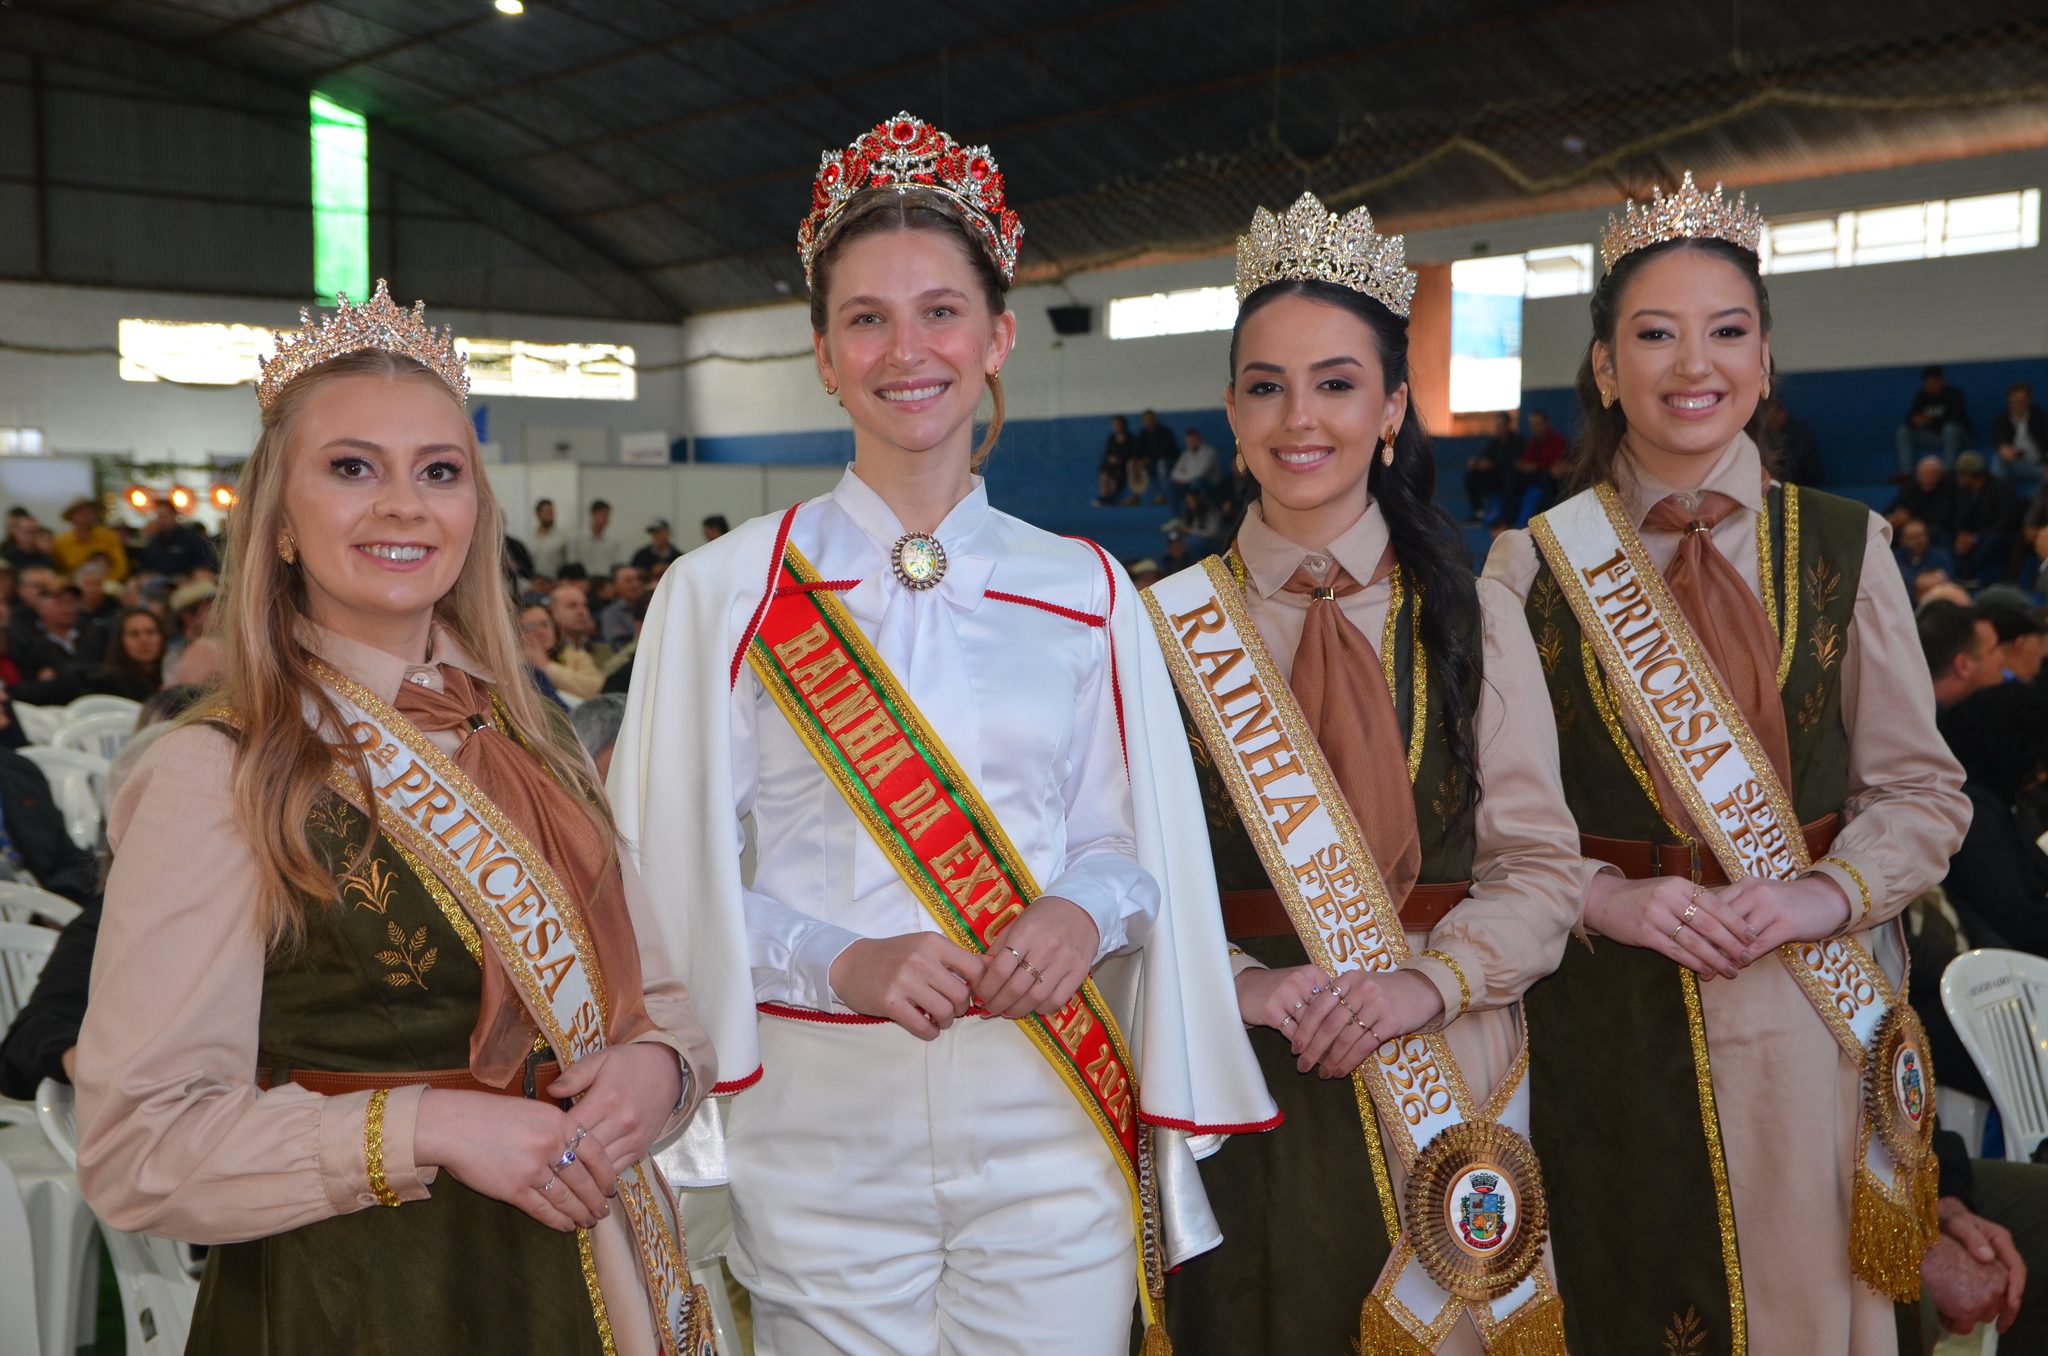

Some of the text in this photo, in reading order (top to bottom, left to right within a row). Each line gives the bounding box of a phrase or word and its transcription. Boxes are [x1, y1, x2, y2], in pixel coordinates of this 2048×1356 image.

[1170, 595, 1321, 845] RAINHA
[1595, 576, 1733, 782] PRINCESA
[375, 759, 576, 1003] PRINCESA
[773, 620, 914, 790] RAINHA
[889, 778, 951, 841] DA
[1085, 1043, 1131, 1133] 2026
[1291, 854, 1428, 1125] FES 026
[1316, 842, 1451, 1114] SEBER GRO
[1711, 792, 1859, 1019] FES 026
[1733, 779, 1875, 1006] SEBE GRO
